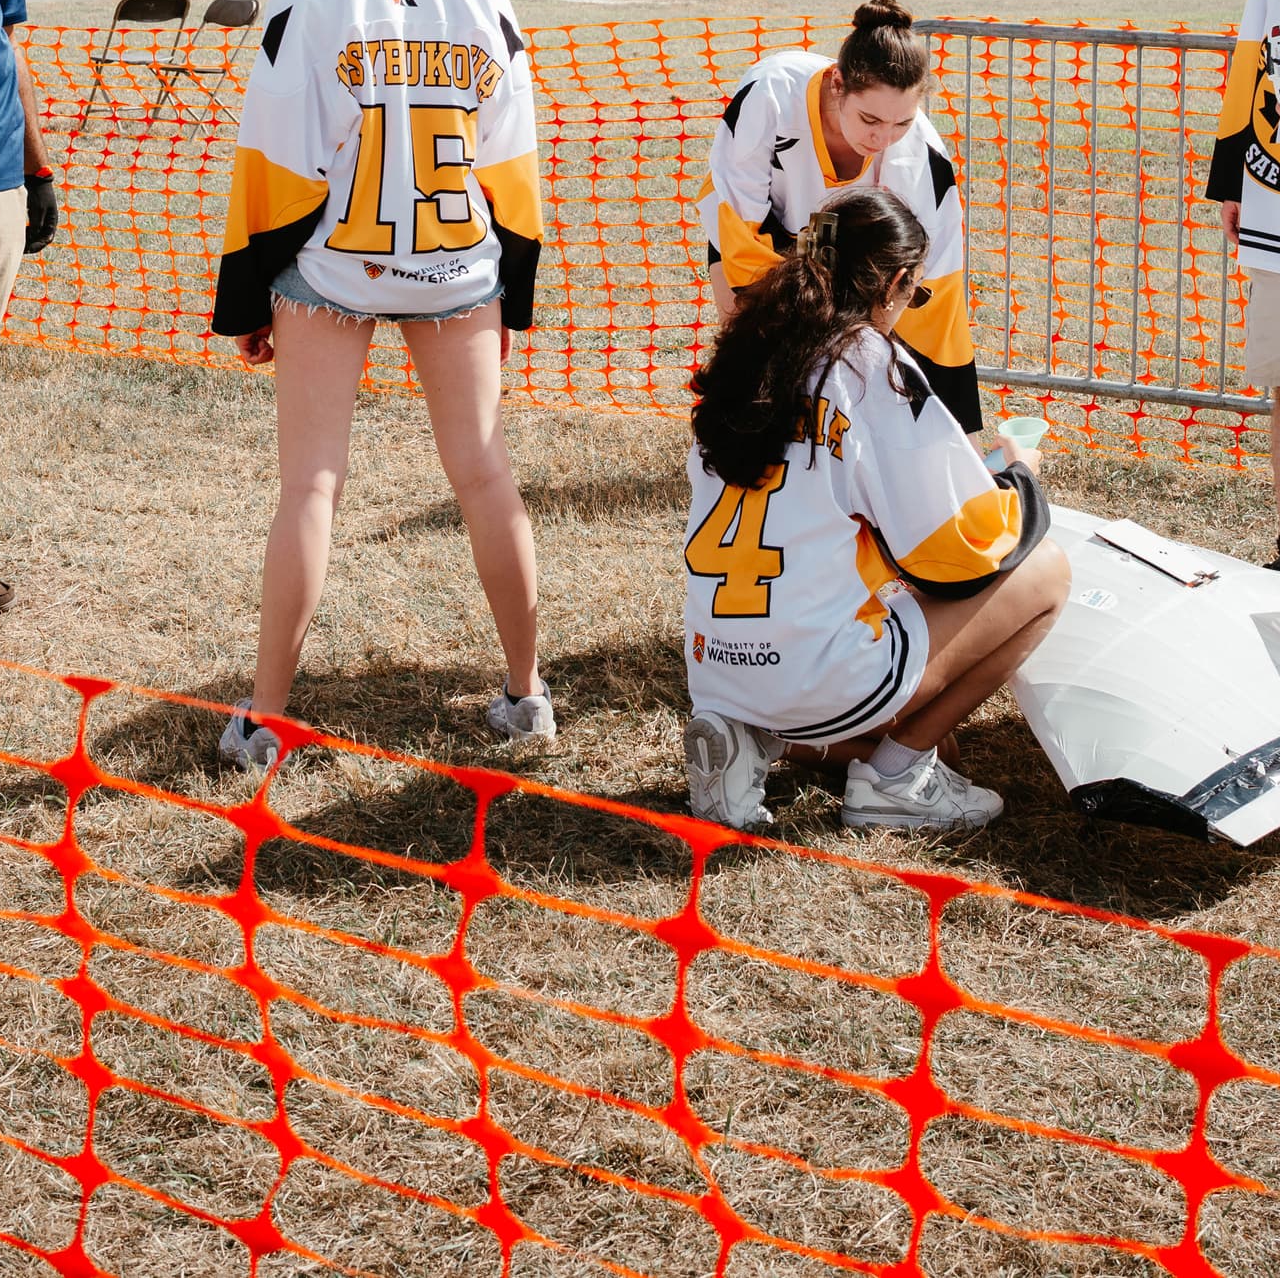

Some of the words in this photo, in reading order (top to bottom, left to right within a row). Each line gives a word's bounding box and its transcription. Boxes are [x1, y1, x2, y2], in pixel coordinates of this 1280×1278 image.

[324, 103, 488, 256] 15
[449, 258, 460, 266] OF
[685, 459, 789, 619] 4
[707, 646, 781, 666] WATERLOO
[759, 642, 772, 650] OF
